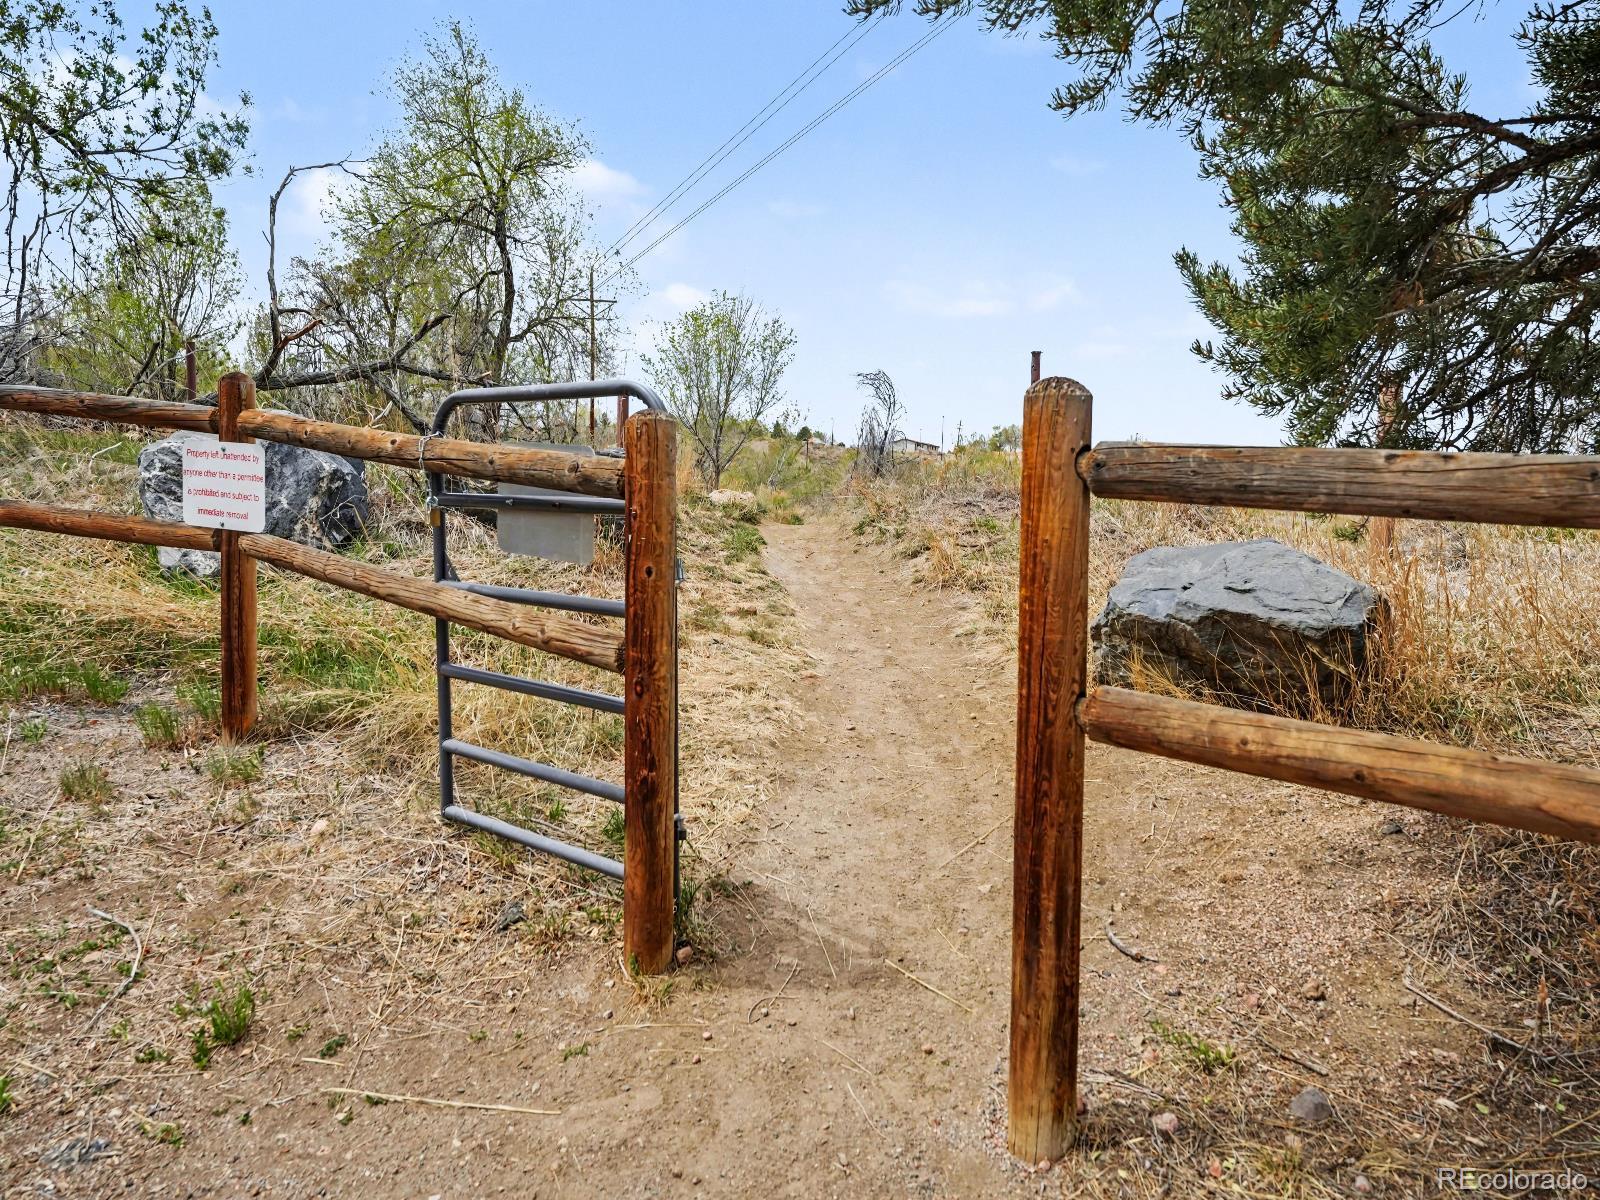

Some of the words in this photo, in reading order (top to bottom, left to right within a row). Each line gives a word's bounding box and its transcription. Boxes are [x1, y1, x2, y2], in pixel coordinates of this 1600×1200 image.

[187, 449, 209, 460] Property
[211, 450, 219, 458] left
[183, 469, 203, 478] anyone
[204, 469, 218, 478] other
[219, 471, 231, 480] than
[193, 488, 220, 498] prohibited
[220, 490, 231, 499] and
[232, 492, 252, 502] subject
[254, 494, 260, 502] to
[226, 511, 248, 520] removal
